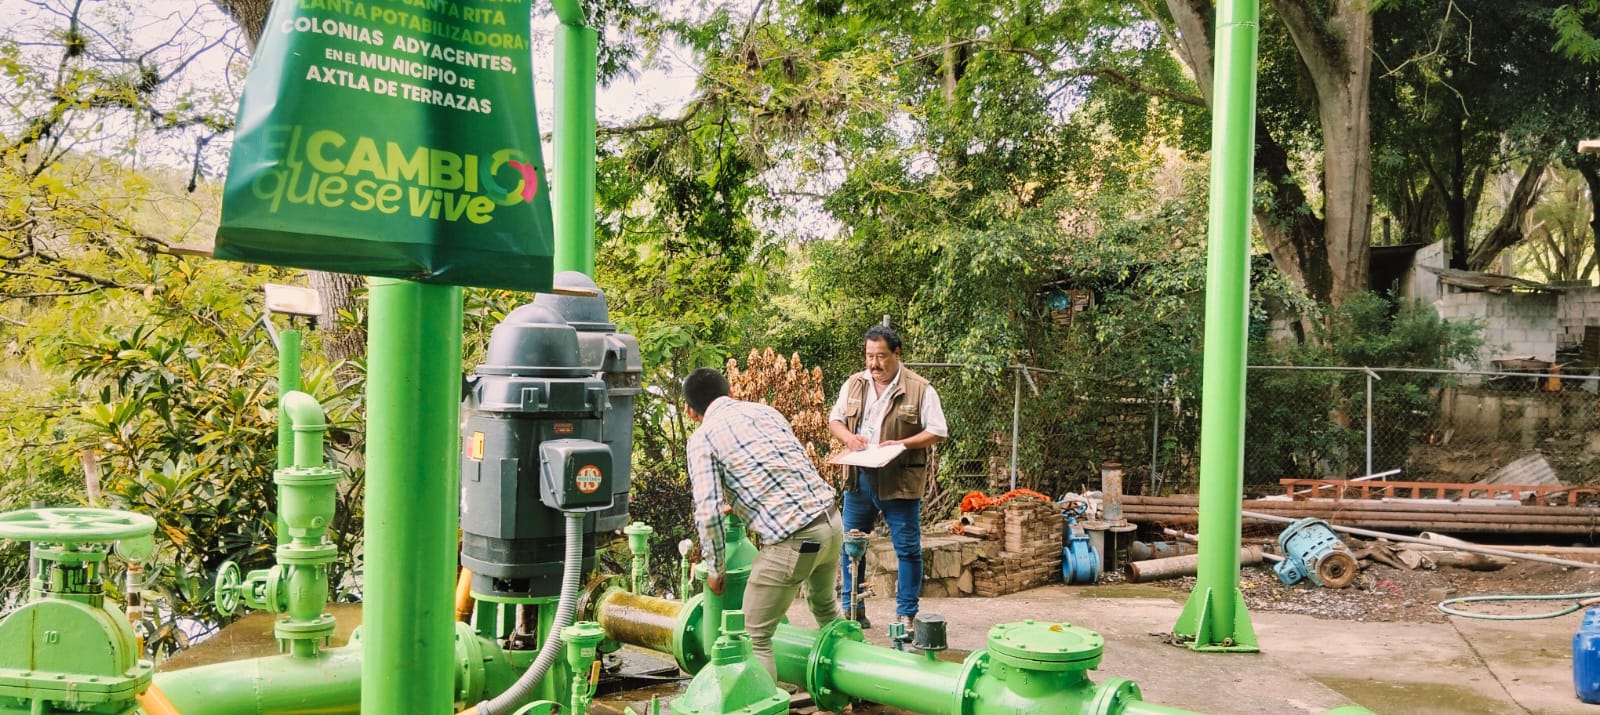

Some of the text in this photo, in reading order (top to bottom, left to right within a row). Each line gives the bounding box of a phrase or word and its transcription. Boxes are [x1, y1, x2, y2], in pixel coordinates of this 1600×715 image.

[296, 0, 368, 19] LANTA
[371, 6, 523, 50] POTABILIZADORA
[463, 6, 506, 26] RITA
[280, 16, 517, 75] COLONIAS ADYACENTES,
[325, 47, 476, 90] EN EL MUNICIPIO DE
[305, 64, 492, 114] AXTLA DE TERRAZAS
[252, 161, 496, 224] que se vive
